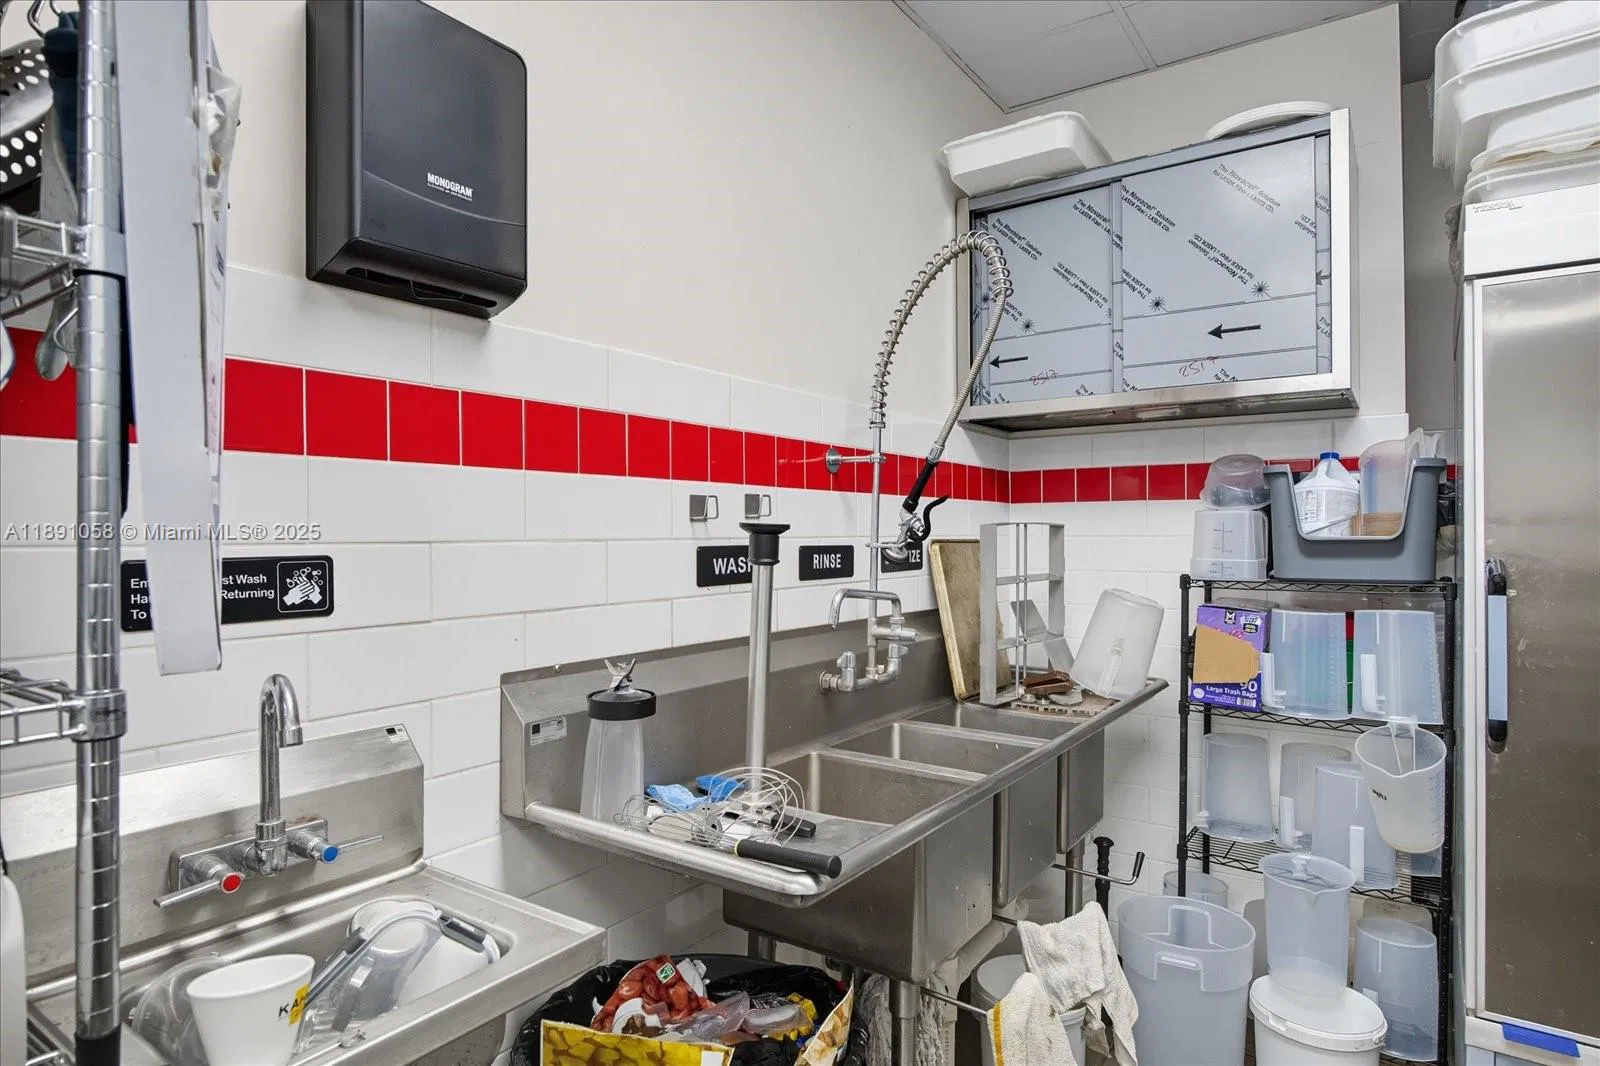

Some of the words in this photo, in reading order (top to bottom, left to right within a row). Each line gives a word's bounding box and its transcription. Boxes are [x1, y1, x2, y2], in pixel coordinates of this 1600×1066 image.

[427, 172, 473, 198] MONOGRAM
[1187, 238, 1209, 257] Solution
[1236, 274, 1248, 285] The
[813, 553, 842, 569] RINSE
[236, 573, 268, 584] Wash
[130, 609, 147, 620] To
[1206, 685, 1224, 694] Large
[1224, 687, 1241, 696] Trash
[1241, 690, 1258, 699] Bags
